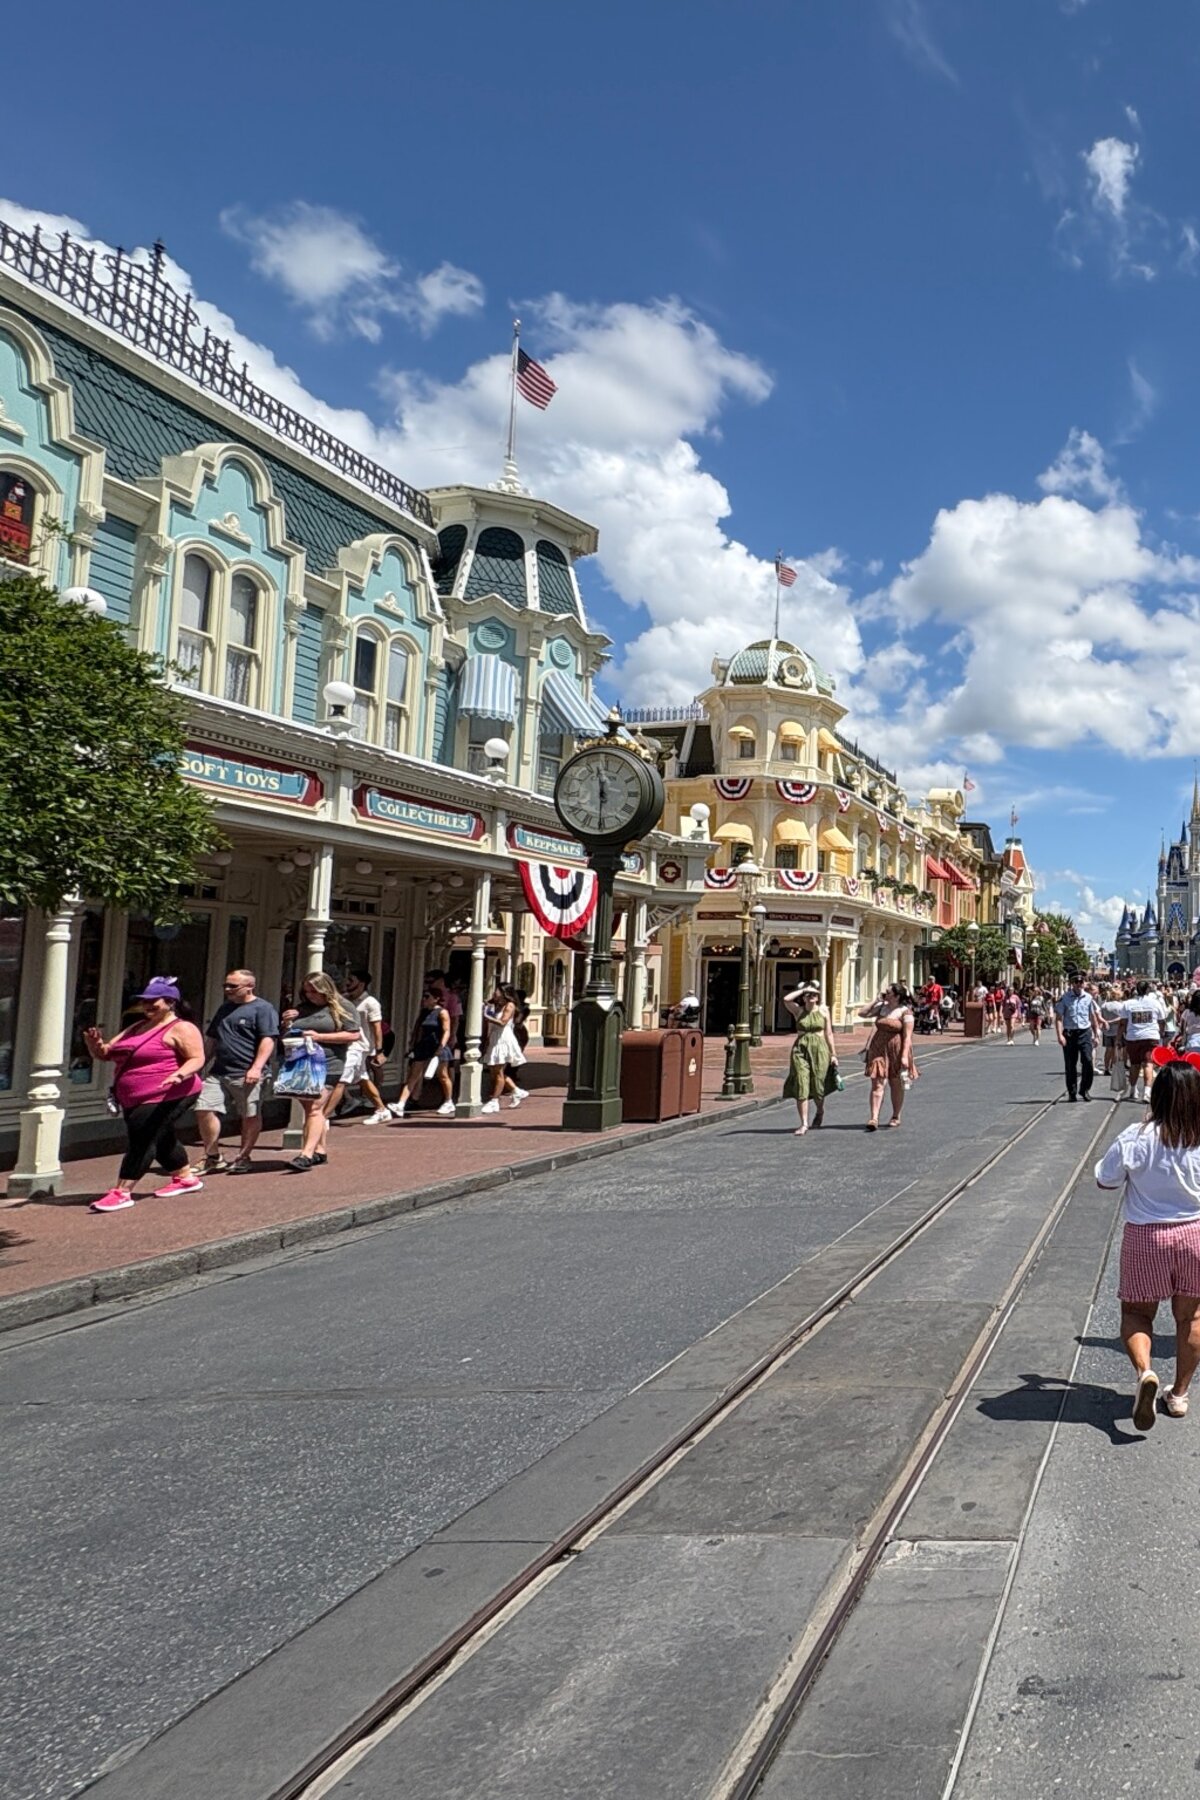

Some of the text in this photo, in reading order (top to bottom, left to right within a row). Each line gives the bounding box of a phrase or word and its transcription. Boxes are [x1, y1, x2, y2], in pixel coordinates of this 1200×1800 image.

[178, 757, 280, 791] SOFT TOYS
[377, 801, 469, 830] COLLECTIBLES
[526, 836, 581, 857] KEEPSAKES
